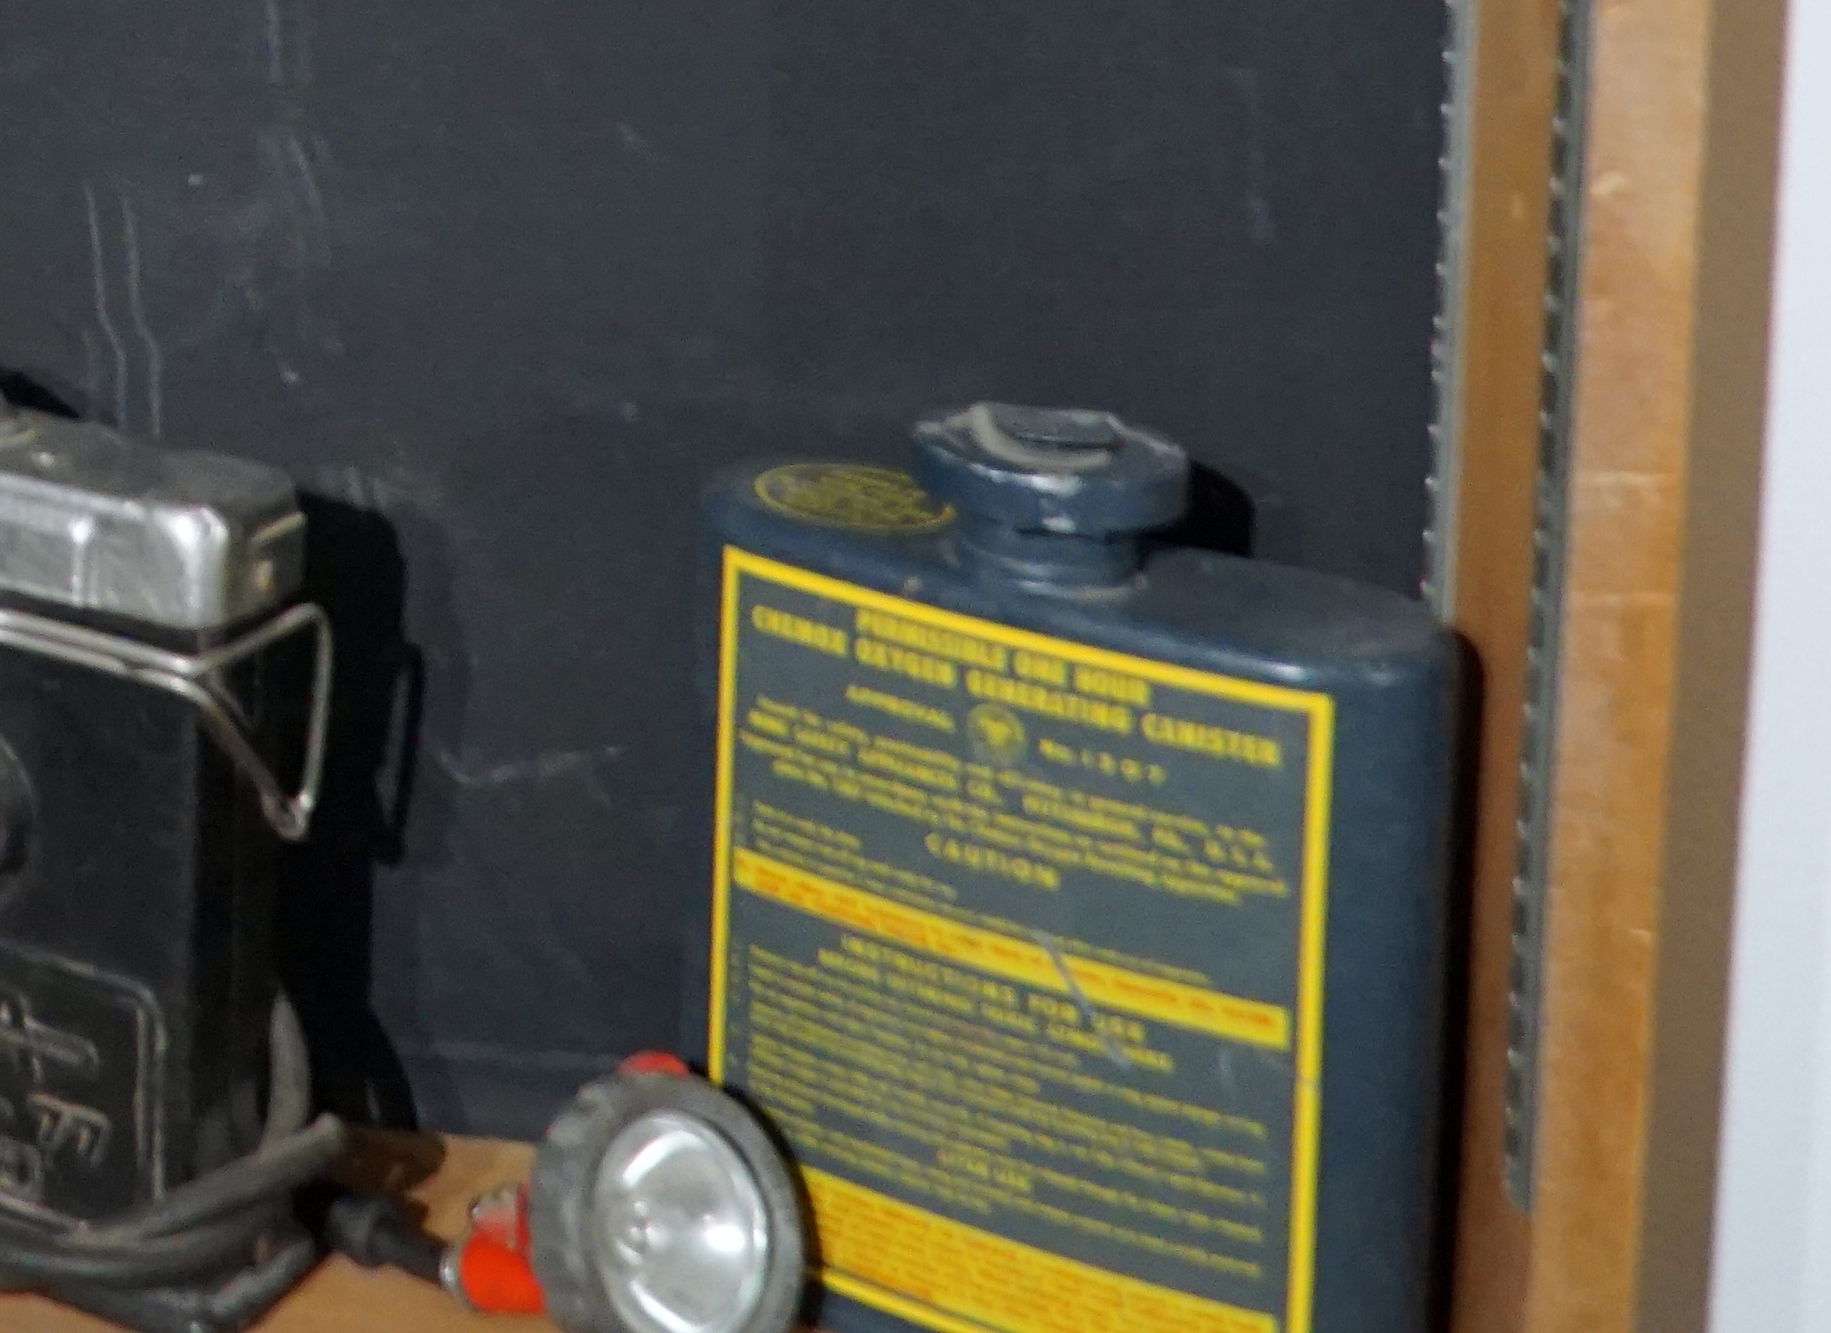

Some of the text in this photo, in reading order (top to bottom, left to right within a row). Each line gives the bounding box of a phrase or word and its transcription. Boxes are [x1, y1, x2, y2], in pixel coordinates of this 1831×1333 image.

[856, 635, 956, 687] OXYGEN
[965, 666, 1133, 732] GENERATING
[1140, 712, 1280, 767] CANISTER
[926, 835, 1060, 888] CAUTION
